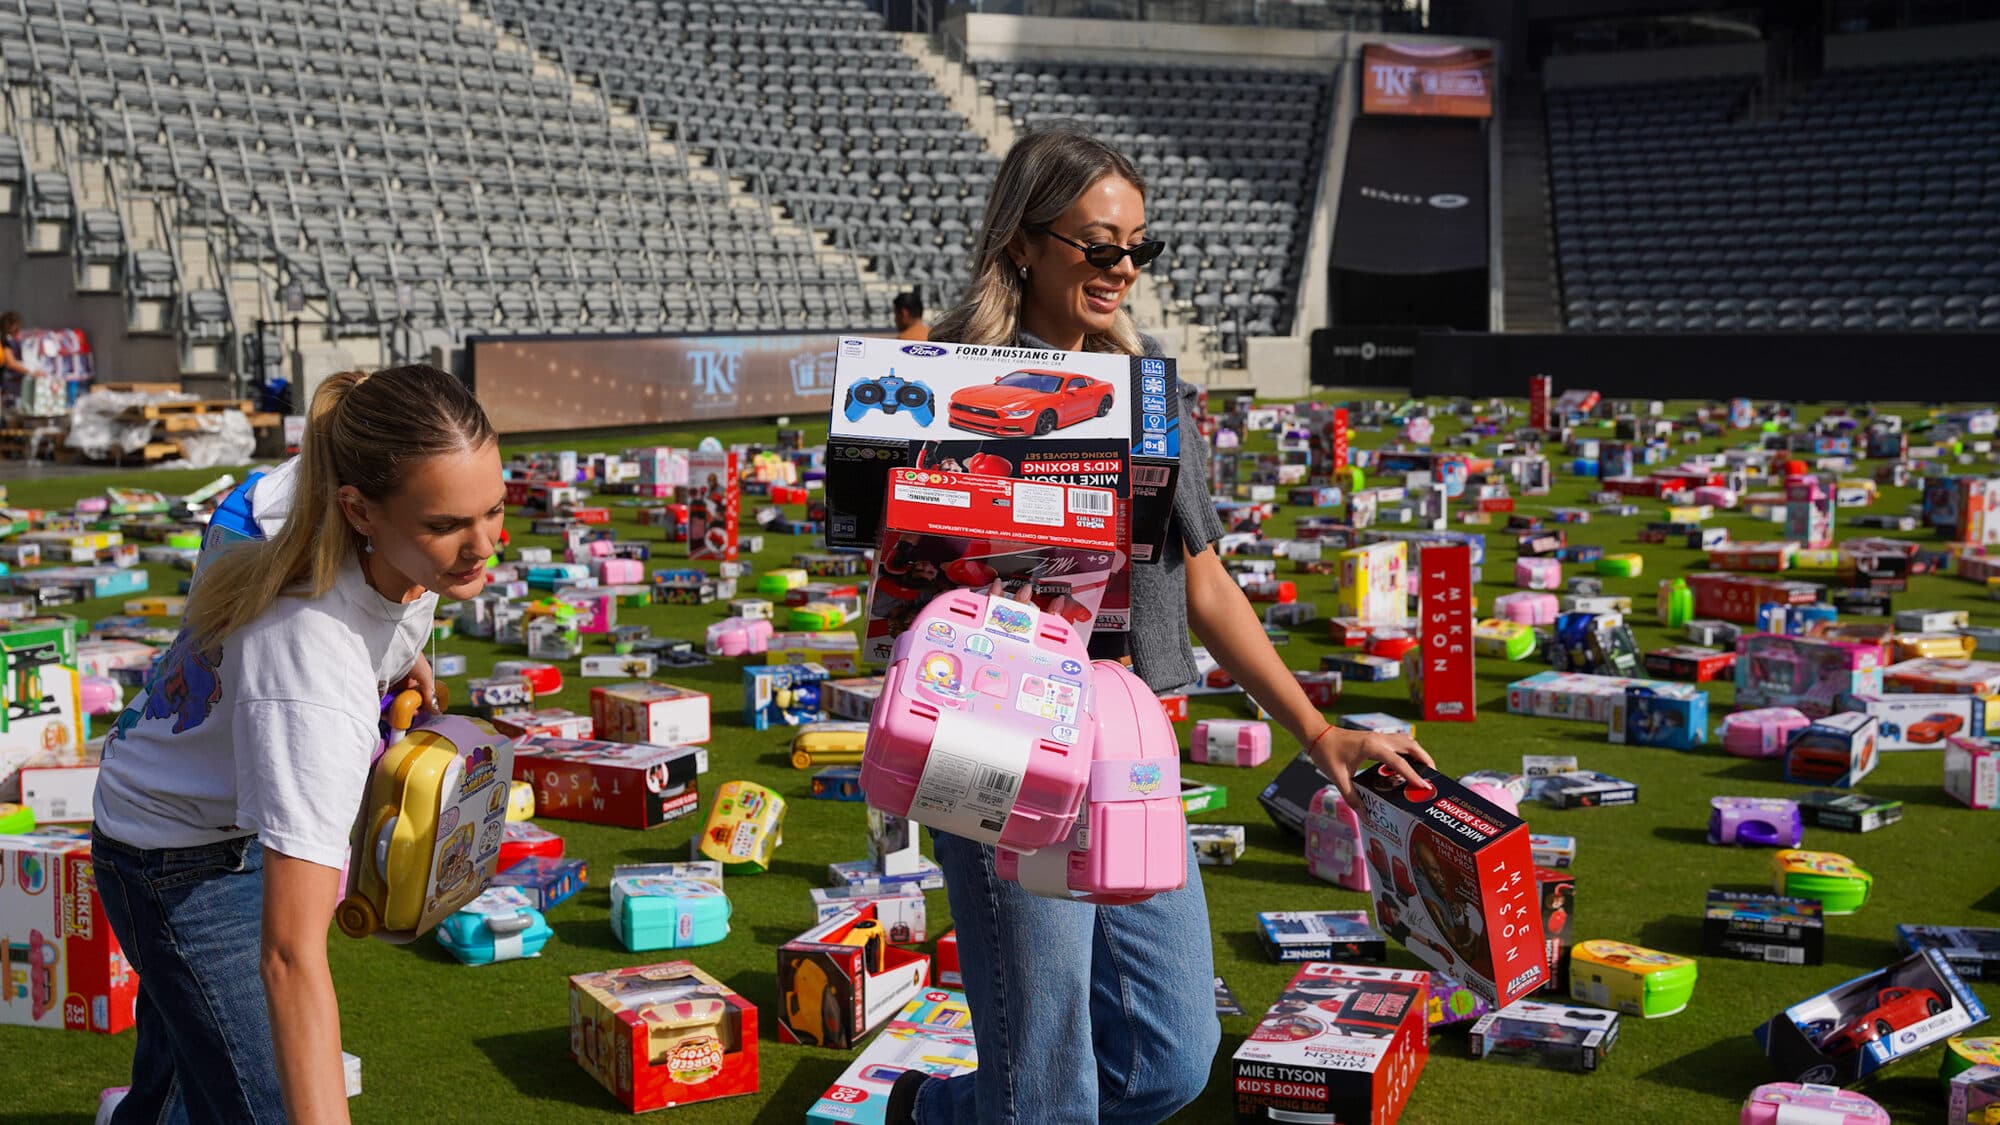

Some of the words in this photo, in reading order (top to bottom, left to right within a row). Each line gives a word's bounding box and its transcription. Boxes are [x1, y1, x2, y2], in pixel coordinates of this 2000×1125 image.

[1371, 65, 1417, 96] TKF
[906, 345, 941, 357] Ford
[956, 346, 989, 356] FORD
[991, 349, 1049, 360] MUSTANG
[1052, 352, 1068, 362] GT
[687, 351, 742, 394] TKF
[1144, 361, 1161, 369] 1:14
[1025, 452, 1040, 460] SET
[1024, 462, 1080, 472] BOXING
[1083, 461, 1119, 471] KID'S
[1080, 474, 1119, 485] MIKE
[1076, 521, 1105, 529] WORLD
[1087, 555, 1109, 564] 6+
[1432, 571, 1447, 672] TYSON
[1450, 588, 1463, 653] MIKE
[1063, 662, 1080, 673] 3+
[1060, 727, 1072, 736] 19
[523, 769, 622, 795] TYSON
[541, 791, 605, 810] MIKE
[1425, 806, 1460, 829] TYSON
[1437, 800, 1474, 821] BOXING
[1369, 808, 1400, 836] YSON
[1471, 820, 1498, 836] KID'S
[1457, 827, 1487, 842] MIKE
[1431, 834, 1454, 854] TRAIN
[1456, 847, 1473, 864] LIKE
[1438, 845, 1452, 859] THE
[75, 861, 91, 938] MARKET
[1510, 870, 1530, 937] MIKE
[1493, 861, 1519, 963] TYSON
[1281, 950, 1331, 959] HORNET
[1506, 965, 1541, 994] ALL-STAR
[72, 1005, 83, 1024] 33
[680, 1046, 711, 1059] STOP
[1304, 1051, 1367, 1063] TYSON
[1318, 1060, 1369, 1069] MIKE
[1239, 1064, 1275, 1079] MIKE
[1278, 1067, 1326, 1084] TYSON
[831, 1092, 854, 1102] 20
[1238, 1080, 1271, 1093] KID'S
[1274, 1084, 1326, 1099] BOXING
[1302, 1101, 1326, 1112] BAG
